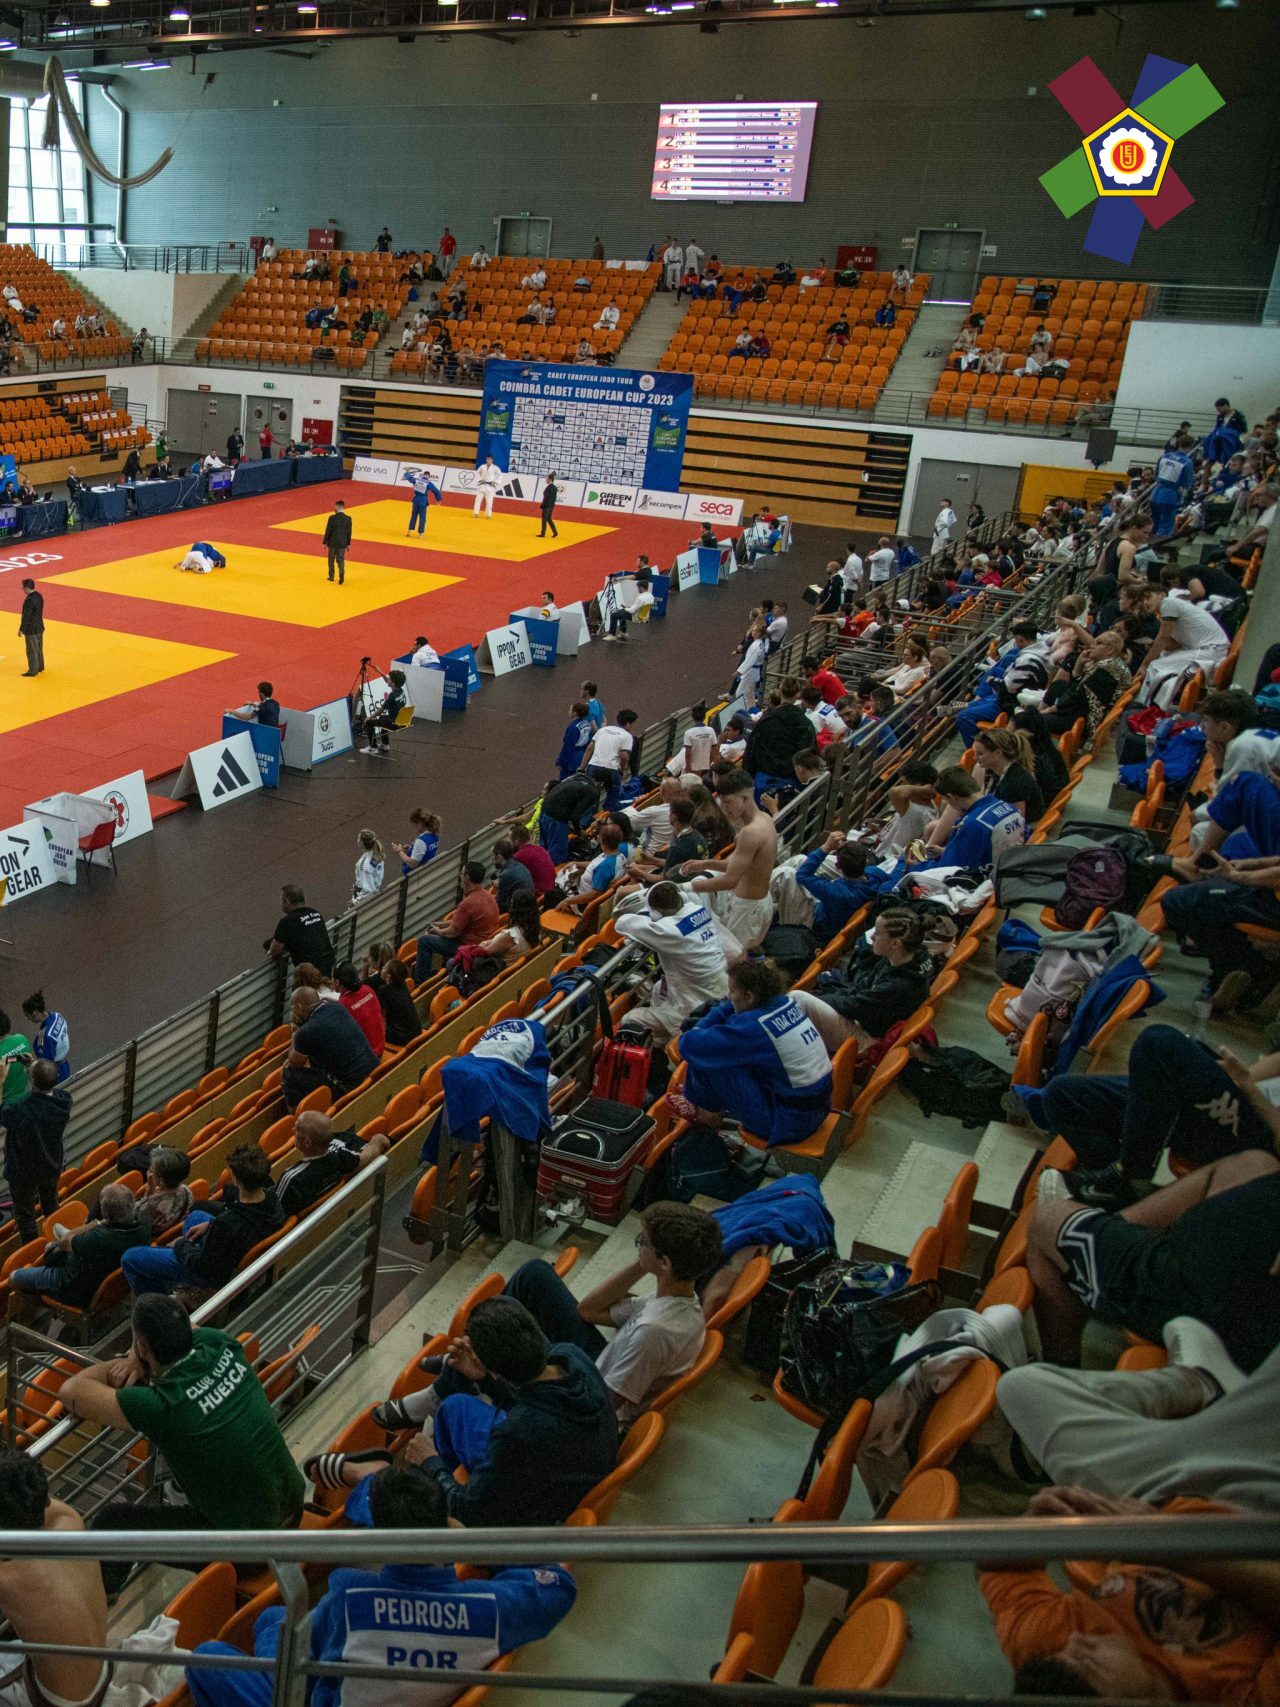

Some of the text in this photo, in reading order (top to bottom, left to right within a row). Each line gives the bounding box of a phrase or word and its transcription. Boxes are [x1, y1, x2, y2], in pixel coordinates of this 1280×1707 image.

[670, 114, 676, 125] 1
[665, 136, 674, 147] 2
[663, 158, 671, 169] 3
[660, 180, 669, 191] 4
[547, 371, 566, 380] CADET
[568, 373, 598, 382] EUROPEAN
[600, 375, 615, 383] JUDO
[617, 377, 633, 385] TOUR
[499, 381, 674, 406] COIMBRA CADET EUROPEAN CUP 2023
[599, 499, 625, 507] HILL
[600, 492, 632, 501] GREEN
[700, 501, 734, 516] seca
[680, 561, 698, 581] essimo
[496, 640, 516, 658] IPPON
[508, 652, 526, 669] GEAR
[1004, 818, 1021, 835] SVK
[48, 843, 74, 856] EUROPEAN
[54, 851, 67, 860] JUDO
[53, 858, 68, 868] UNION
[6, 865, 43, 896] GEAR
[700, 929, 715, 943] ITA
[800, 1026, 819, 1046] ITA
[185, 1347, 235, 1400] CLUB JUDO
[198, 1361, 248, 1415] HUESCA
[373, 1597, 471, 1631] PEDROSA
[386, 1645, 459, 1670] POR
